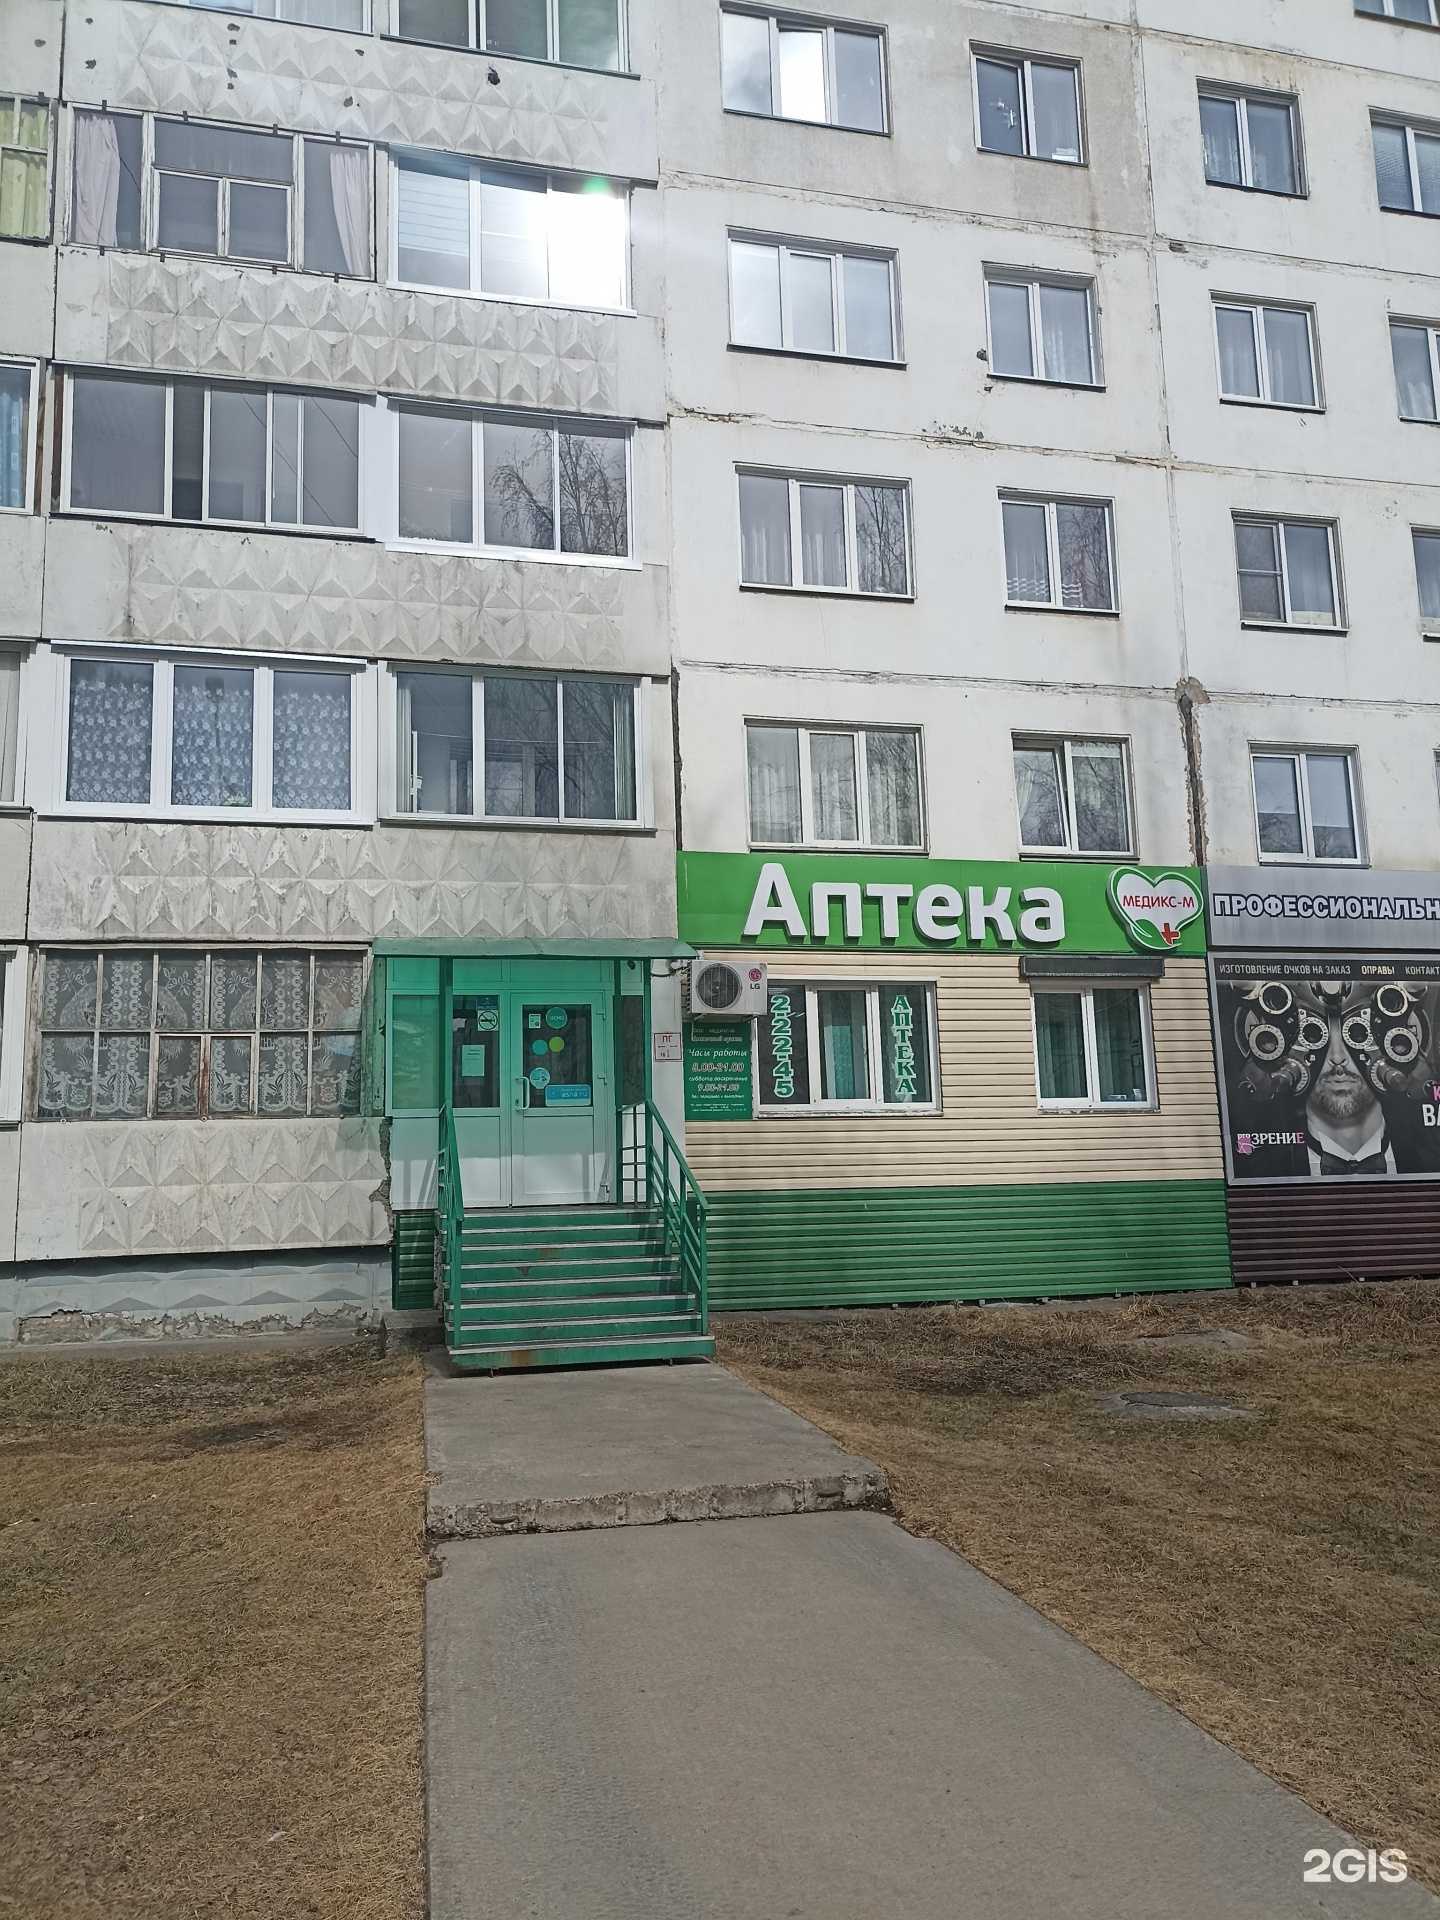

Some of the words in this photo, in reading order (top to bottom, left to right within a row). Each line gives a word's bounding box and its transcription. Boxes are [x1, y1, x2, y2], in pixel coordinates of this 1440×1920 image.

[743, 862, 1066, 943] Аптека
[1122, 895, 1195, 909] МЕДИКС-М
[1219, 964, 1282, 975] ИЗГОТОВЛЕНИЕ
[1283, 965, 1311, 975] ОЧКОВ
[1312, 966, 1323, 975] НА
[1325, 965, 1351, 975] ЗАКАЗ
[1361, 965, 1395, 976] ОПРАВЫ
[891, 994, 917, 1096] АПТЕКА
[688, 1048, 710, 1057] Часы
[712, 1048, 747, 1059] работы
[1422, 1103, 1440, 1126] В
[1251, 1133, 1305, 1145] ЗРЕНИЕ
